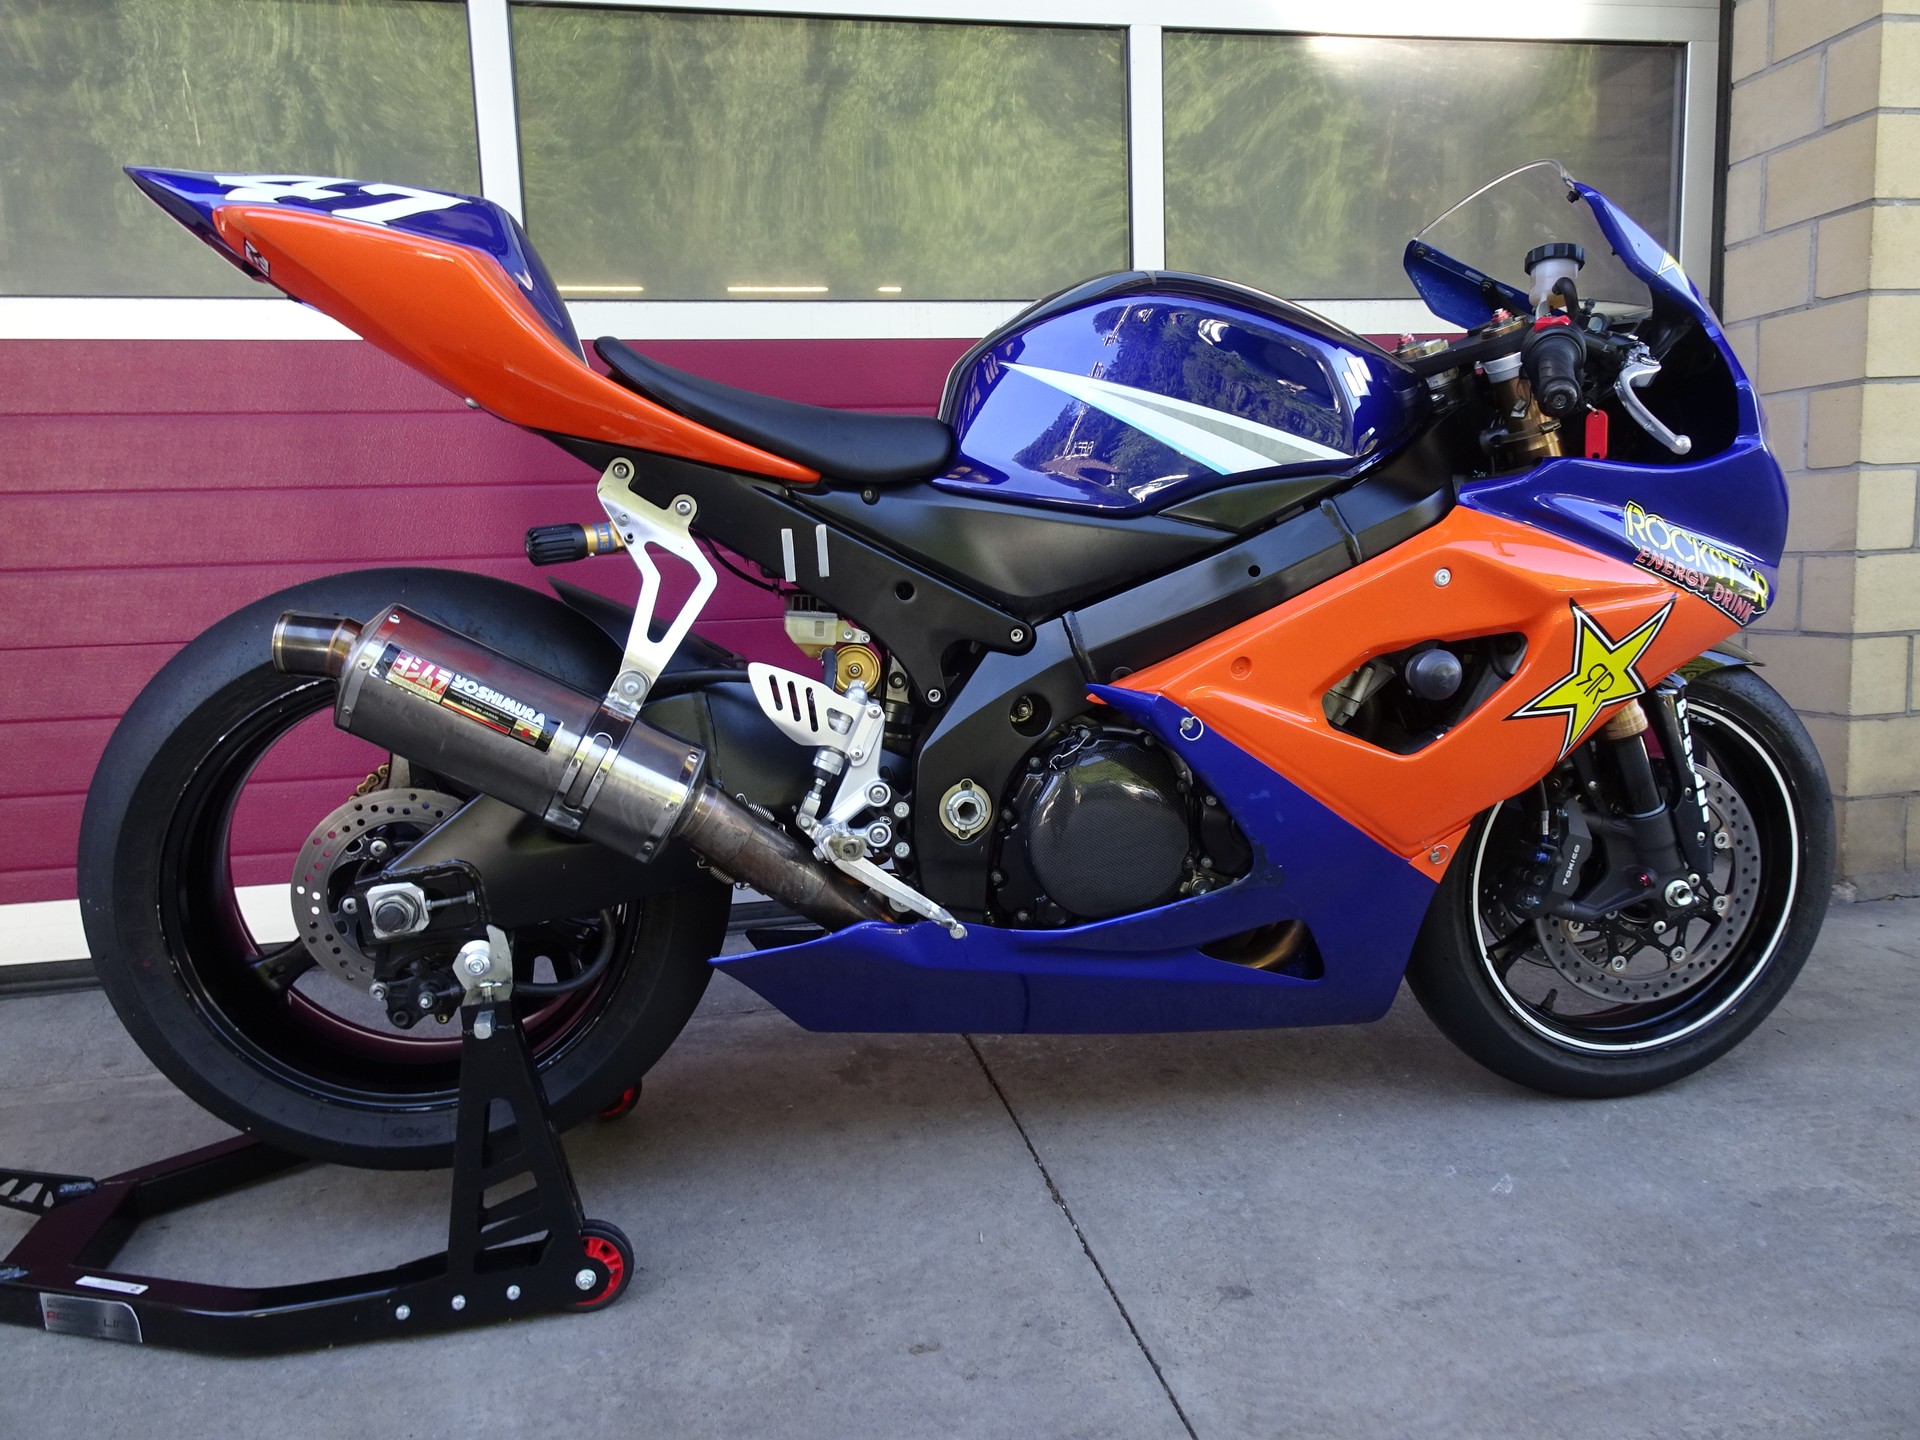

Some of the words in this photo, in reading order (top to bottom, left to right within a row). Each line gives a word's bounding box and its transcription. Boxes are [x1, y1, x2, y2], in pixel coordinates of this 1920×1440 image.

[1626, 503, 1770, 609] ROCKSTR
[1635, 545, 1710, 592] ENERGY
[1712, 582, 1756, 622] DRINK
[392, 652, 453, 694] ヨシムラ
[450, 674, 546, 727] YOSHIMURA
[1562, 844, 1581, 886] TOKICO
